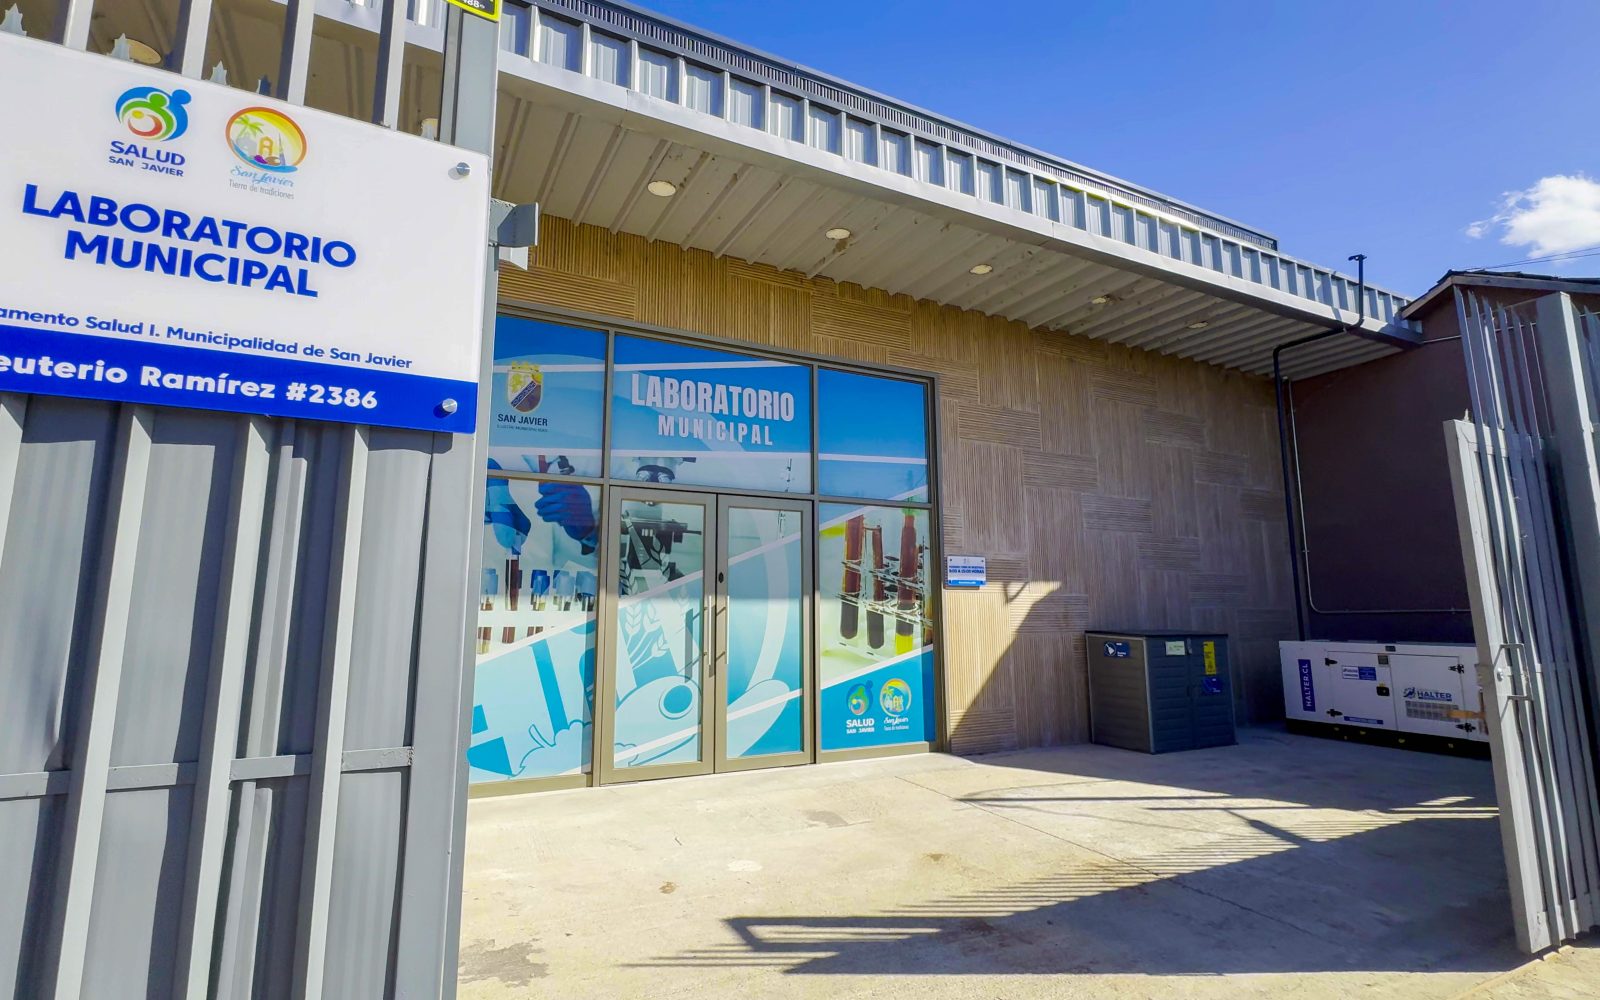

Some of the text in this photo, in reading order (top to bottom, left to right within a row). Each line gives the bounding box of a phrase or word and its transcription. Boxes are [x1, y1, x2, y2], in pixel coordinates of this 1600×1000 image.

[108, 156, 184, 177] SAN JAVIER
[110, 140, 186, 167] SALUD
[229, 178, 295, 200] Tierra de tradiciones
[22, 183, 357, 268] LABORATORIO
[64, 229, 319, 298] MUNICIPAL
[85, 315, 143, 335] Salud
[166, 326, 298, 355] Municipalidad
[303, 344, 325, 358] de
[329, 347, 361, 363] San
[364, 352, 412, 369] Javier
[140, 365, 275, 399] Ramírez
[286, 382, 378, 410] #2386
[631, 373, 795, 422] LABORATORIO
[497, 413, 548, 427] SAN JAVIER
[658, 414, 773, 446] MUNICIPAL
[1302, 663, 1312, 707] HALTER.CL
[1417, 690, 1452, 699] HALTER
[846, 718, 875, 728] SALUD
